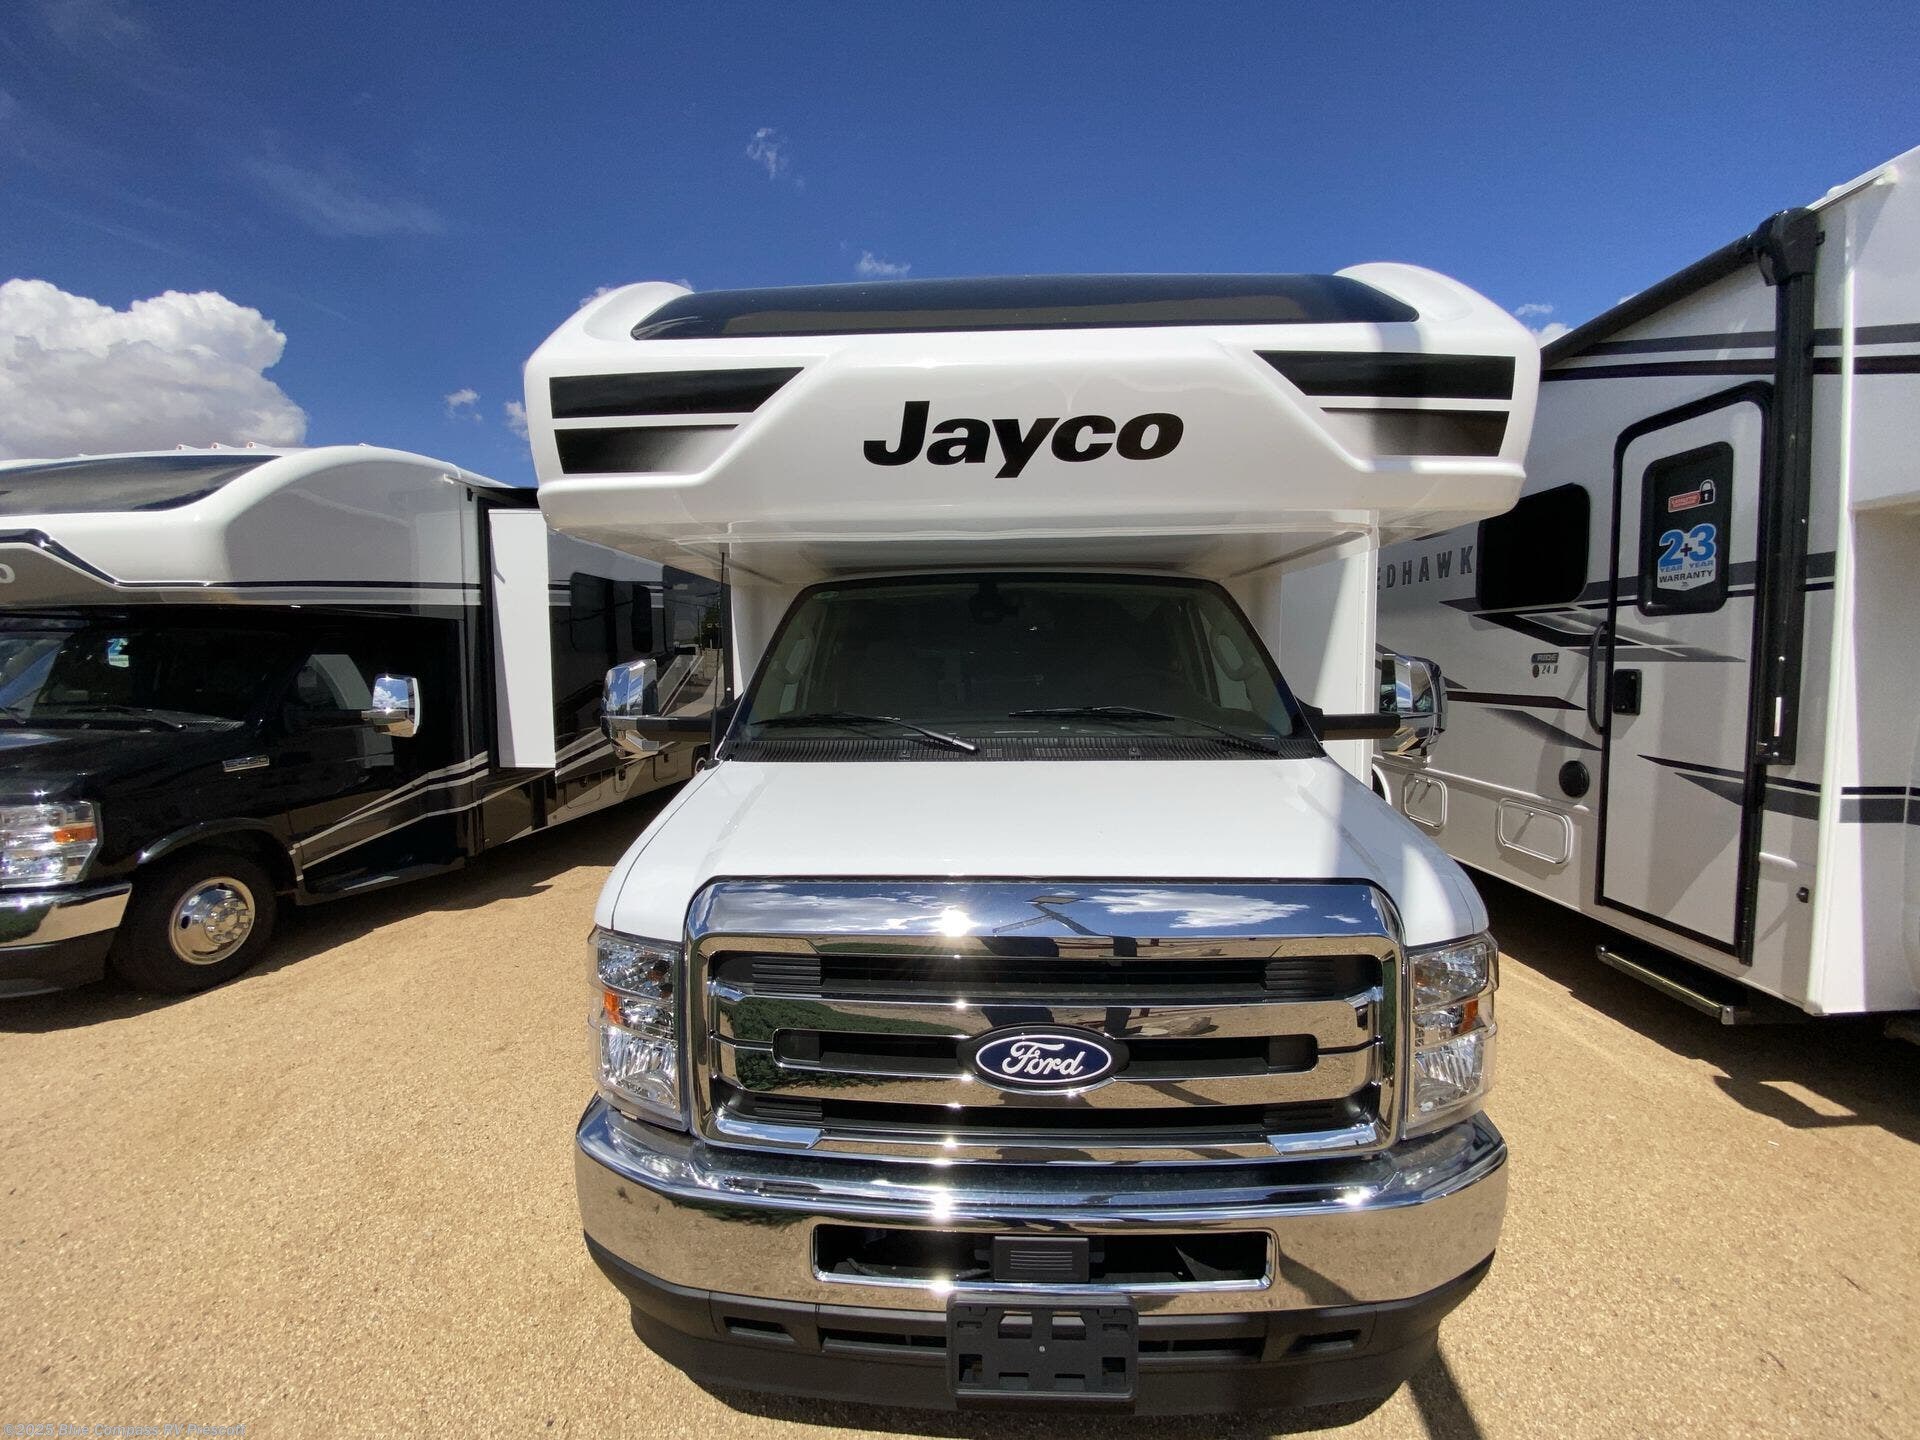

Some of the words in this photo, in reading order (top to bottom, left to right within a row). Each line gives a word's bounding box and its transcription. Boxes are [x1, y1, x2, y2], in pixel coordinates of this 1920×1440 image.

[863, 400, 1184, 478] Jayco
[1659, 570, 1713, 583] WARRANTY
[1001, 1041, 1086, 1075] Ford
